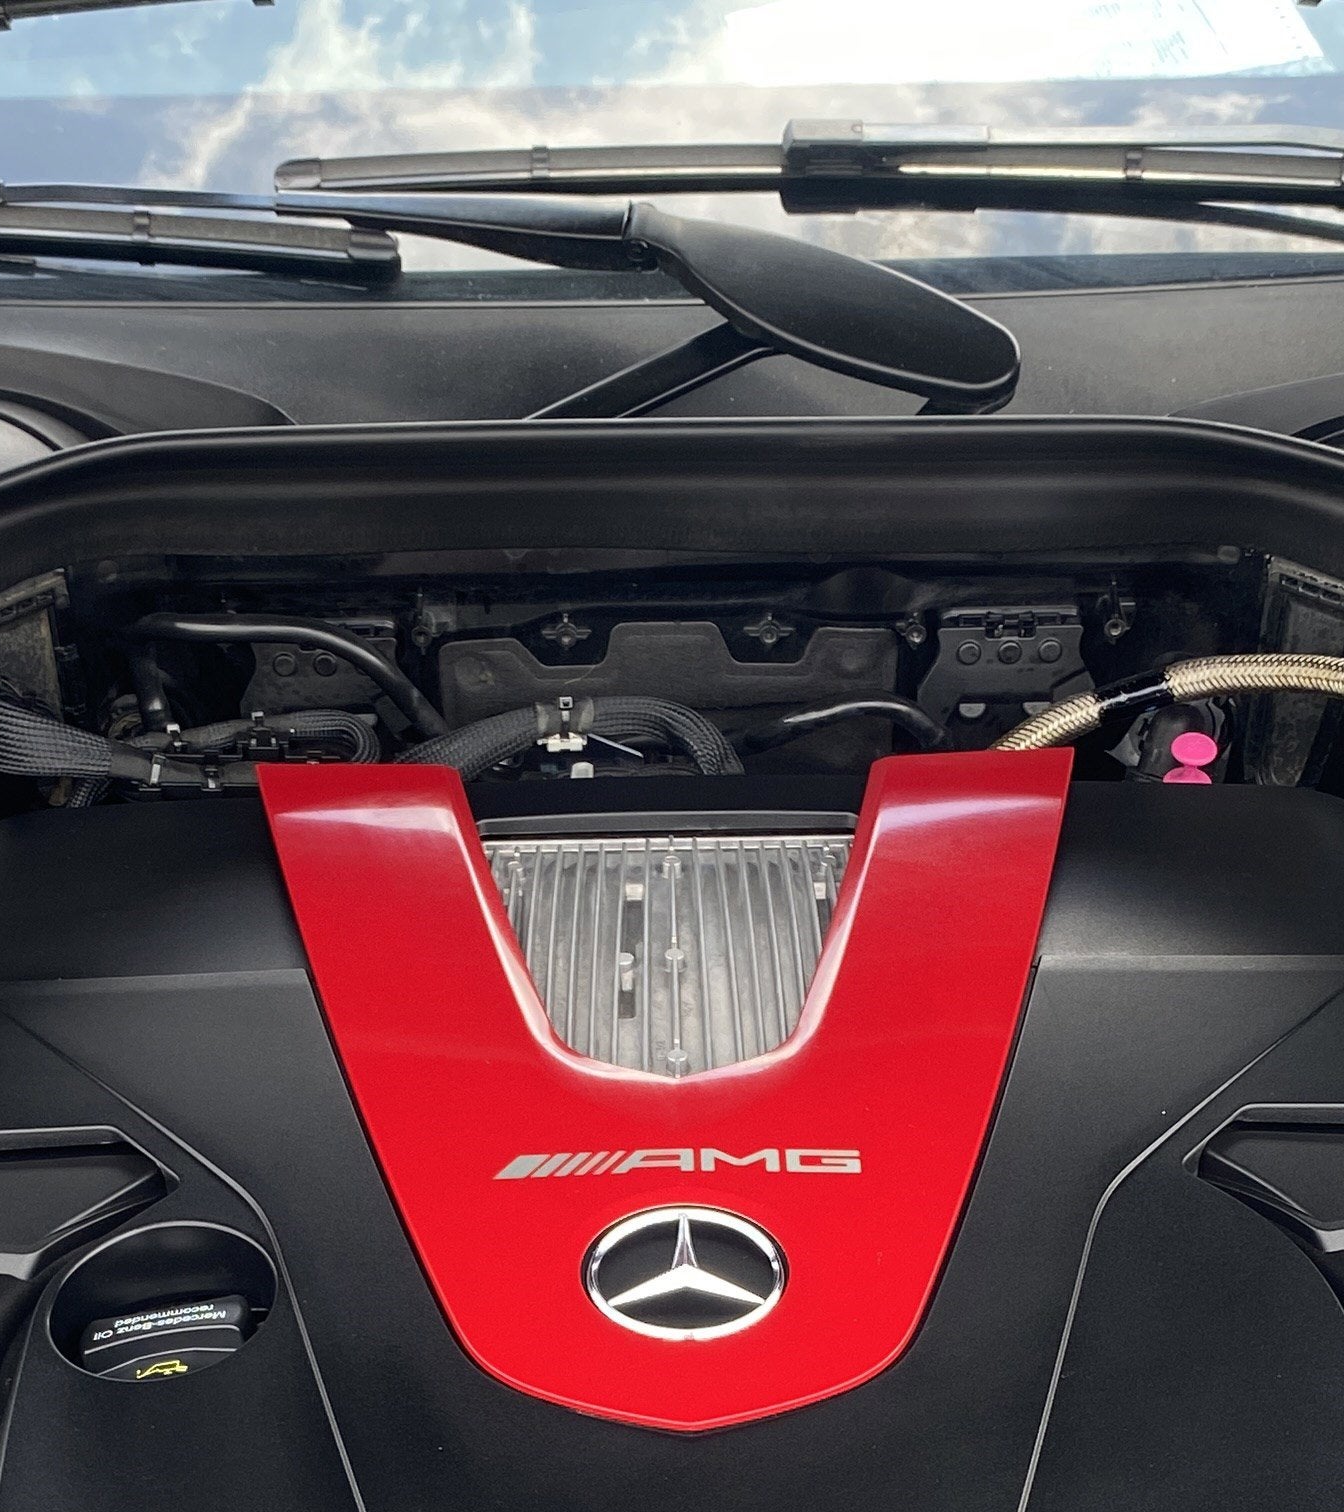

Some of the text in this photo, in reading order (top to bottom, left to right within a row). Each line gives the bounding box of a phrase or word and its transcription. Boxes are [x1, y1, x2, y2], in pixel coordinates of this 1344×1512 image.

[612, 1148, 862, 1174] AMG
[93, 1311, 226, 1341] Mercedes-Benz Oil
[114, 1304, 214, 1328] recommended
